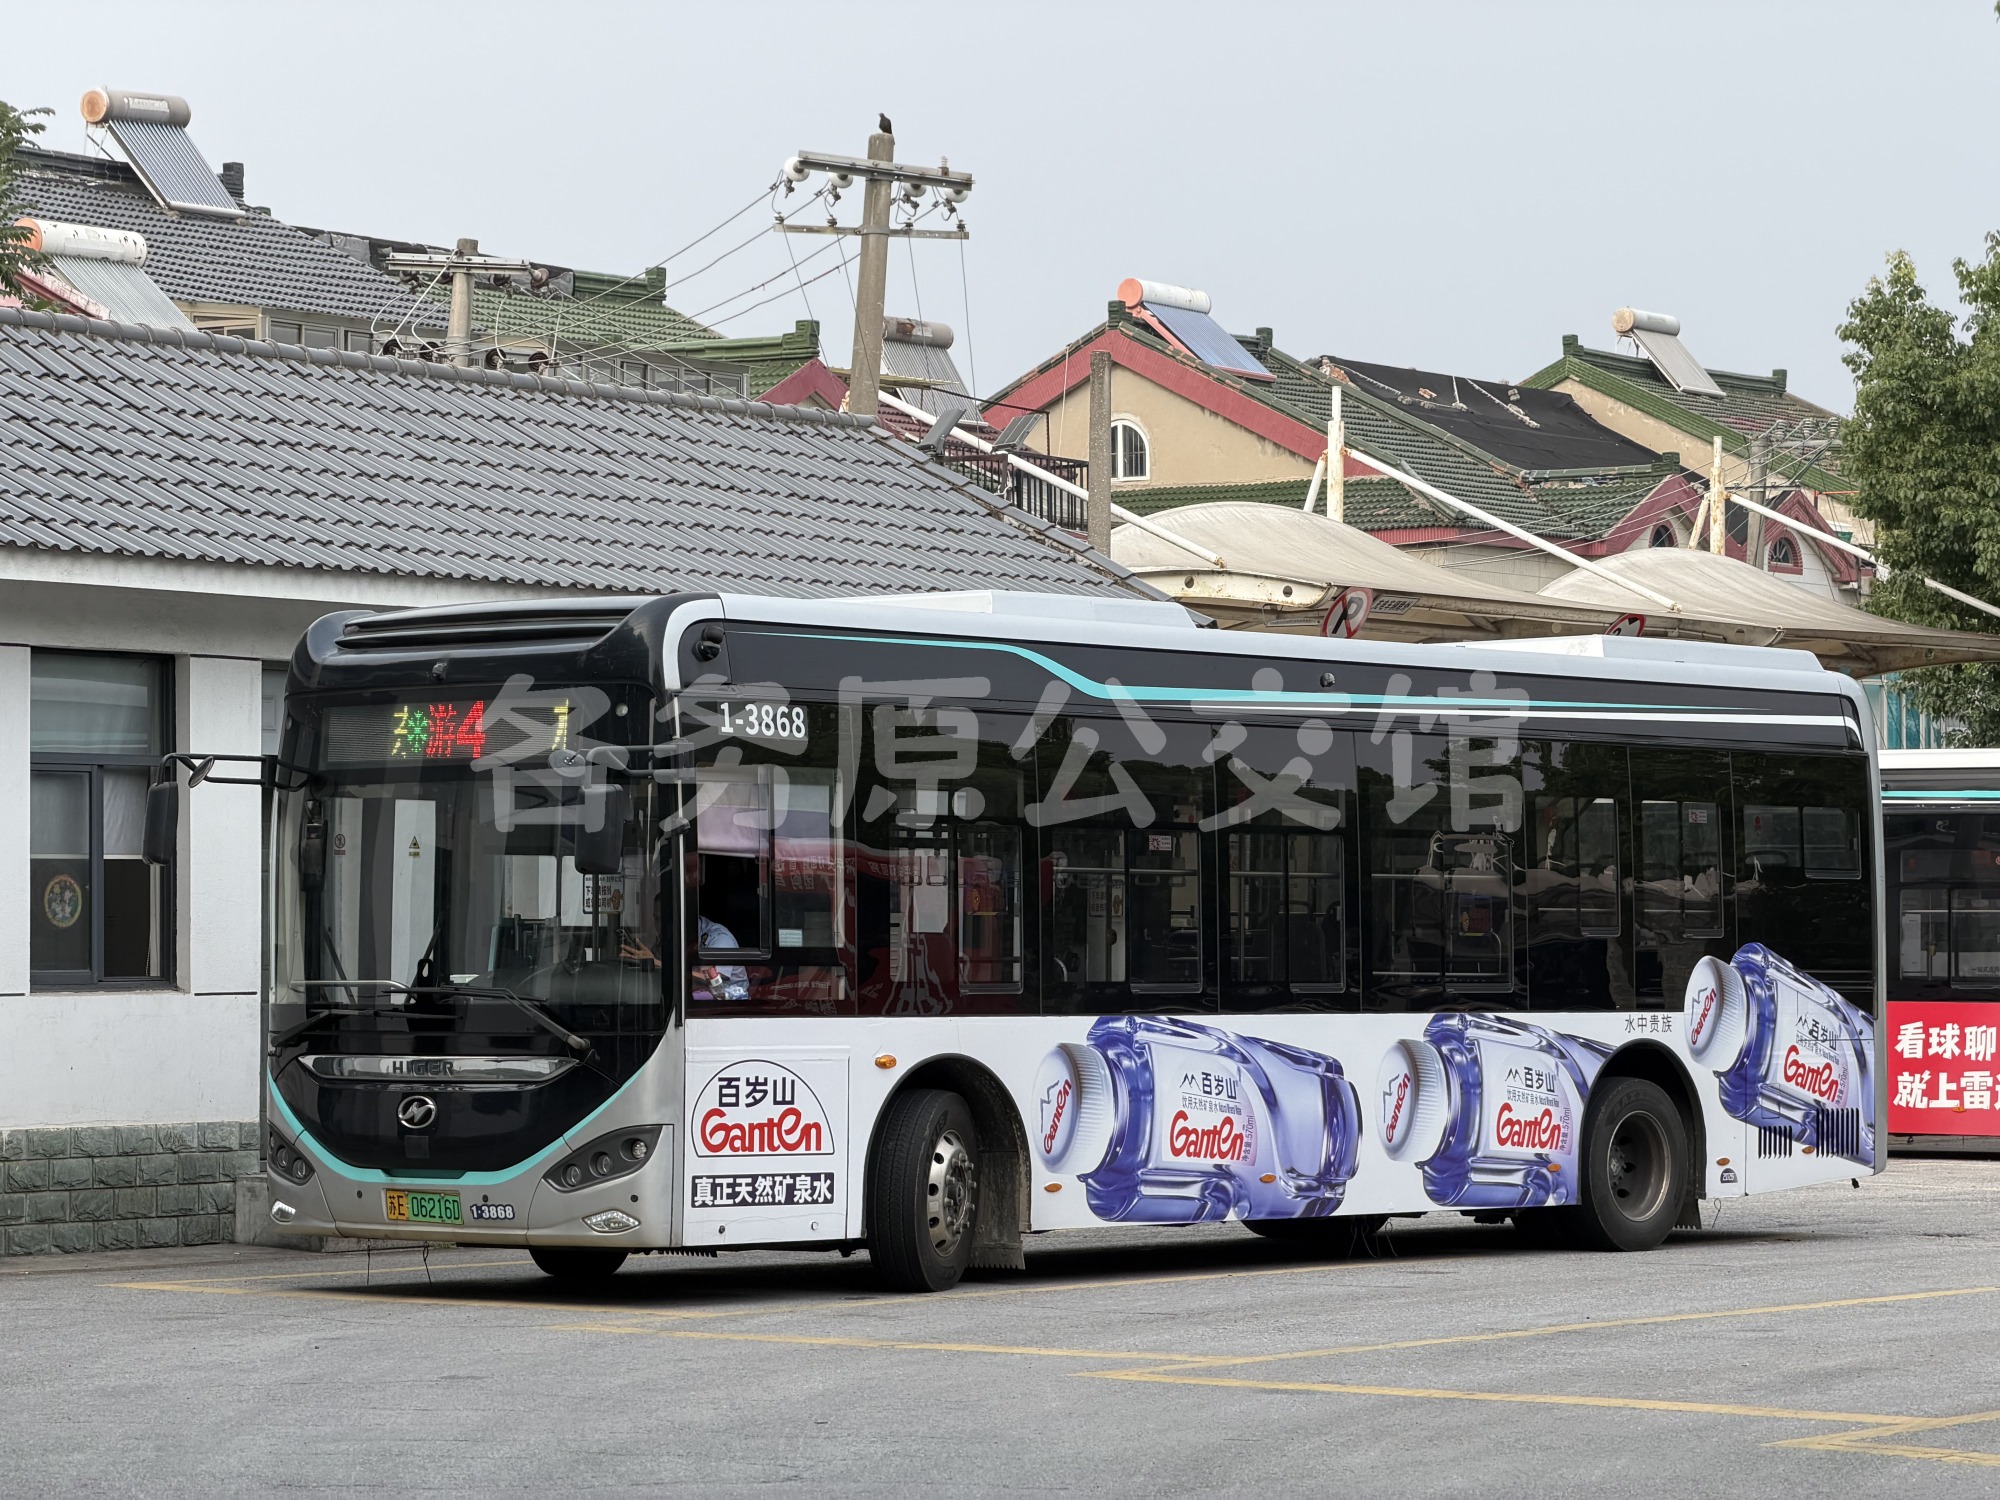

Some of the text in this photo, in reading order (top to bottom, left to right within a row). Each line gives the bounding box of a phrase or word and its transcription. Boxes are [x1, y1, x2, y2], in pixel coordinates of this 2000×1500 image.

[720, 702, 806, 738] 1-3868
[1624, 1014, 1672, 1033] 水中贵族
[1811, 1018, 1837, 1051] 百岁山
[1894, 1020, 1997, 1061] 看球聊
[393, 1060, 454, 1077] HIGER
[1523, 1066, 1555, 1093] 百岁山
[718, 1076, 795, 1108] 百岁山
[1201, 1071, 1237, 1100] 百岁山
[1893, 1070, 2000, 1110] 就上雷
[700, 1107, 822, 1153] Ganten
[694, 1174, 832, 1206] 真正天然矿泉水
